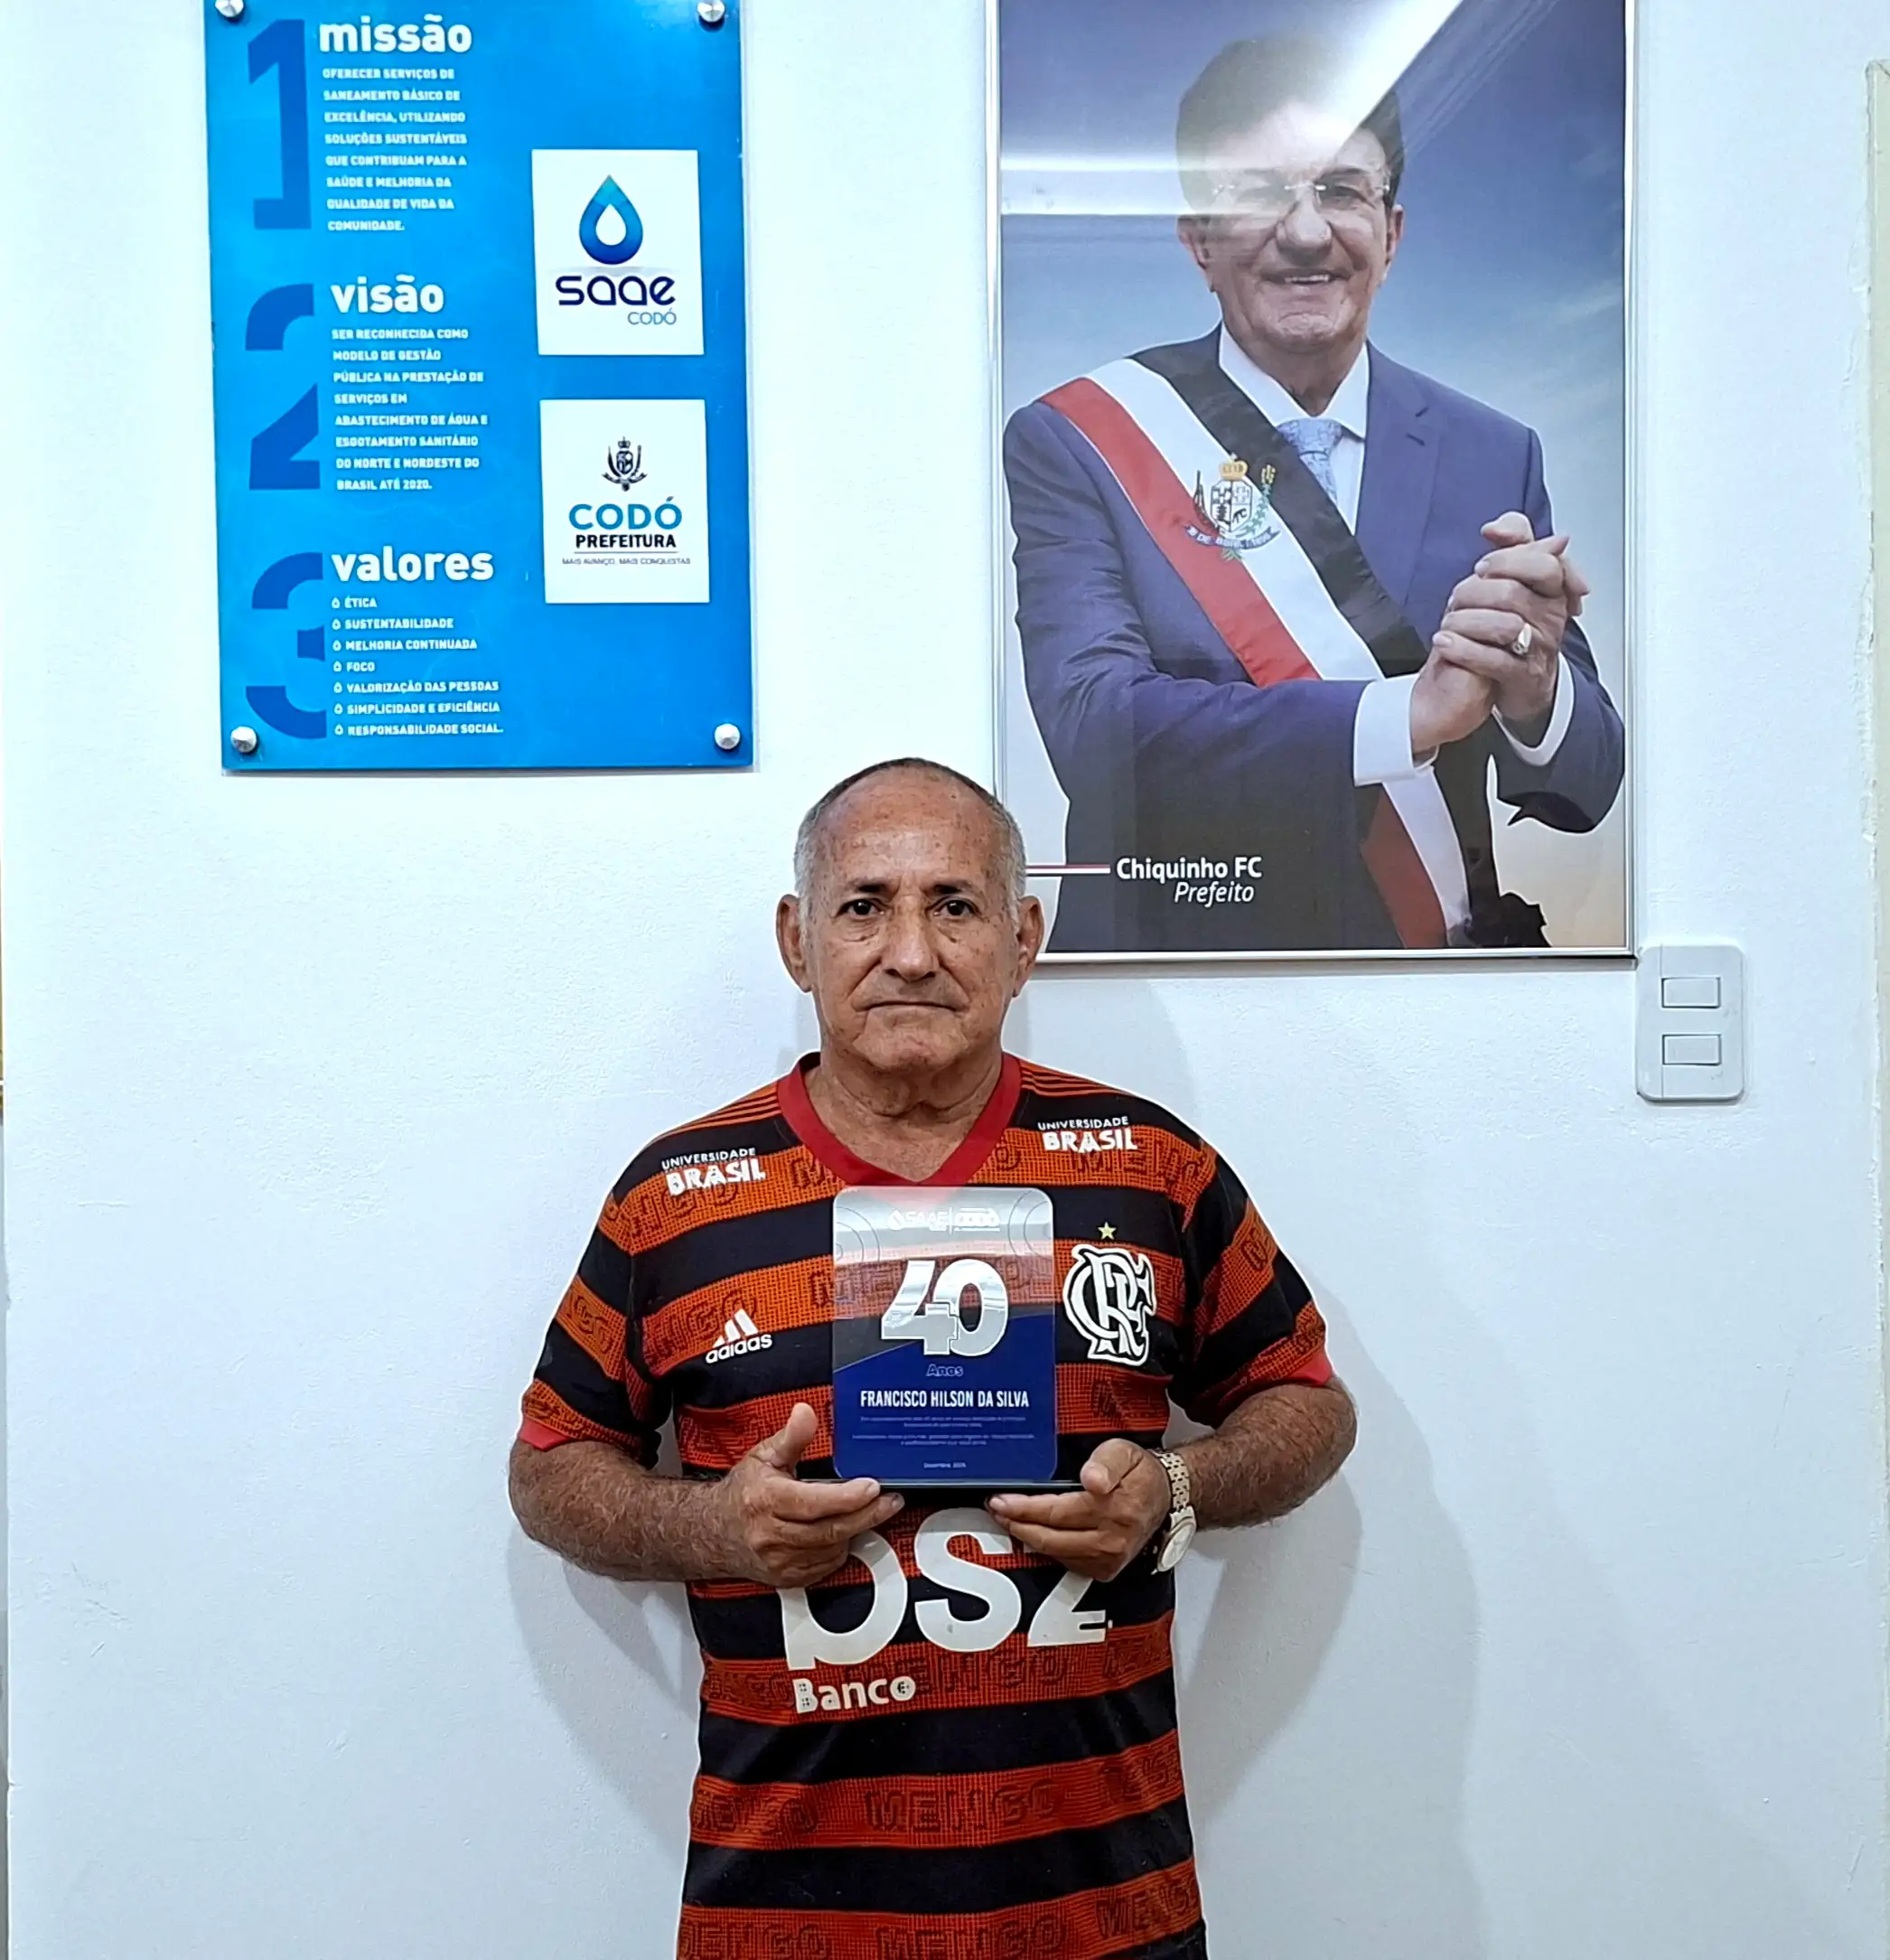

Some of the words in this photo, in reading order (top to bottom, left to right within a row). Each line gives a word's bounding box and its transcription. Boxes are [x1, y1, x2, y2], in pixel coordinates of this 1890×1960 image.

[319, 14, 472, 53] missão
[323, 68, 380, 80] OFERECER
[384, 68, 437, 80] SERVIÇOS
[440, 69, 454, 80] DE
[323, 90, 399, 101] SANEAMENTO
[403, 88, 443, 101] BÁSICO
[445, 90, 460, 101] DE
[324, 110, 398, 124] EXCELÊNCIA,
[399, 112, 465, 123] UTILIZANDO
[248, 19, 312, 230] 1
[325, 132, 382, 146] SOLUÇÕES
[385, 133, 467, 145] SUSTENTÁVEIS
[325, 156, 348, 165] QUE
[351, 156, 424, 165] CONTRIBUAM
[426, 156, 455, 165] PARA
[458, 156, 467, 165] A
[326, 175, 363, 188] SAÚDE
[366, 177, 373, 187] E
[376, 177, 434, 187] MELHORIA
[436, 177, 452, 187] DA
[327, 199, 389, 210] QUALIDADE
[393, 199, 407, 209] DE
[409, 199, 435, 209] VIDA
[438, 199, 454, 209] DA
[328, 220, 405, 230] COMUNIDADE.
[331, 275, 444, 313] visão
[556, 275, 676, 306] saae
[627, 308, 677, 325] CODÓ
[332, 330, 353, 340] SER
[356, 329, 435, 339] RECONHECIDA
[437, 329, 468, 339] COMO
[333, 351, 379, 361] MODELO
[381, 351, 396, 361] DE
[398, 348, 441, 360] GESTÃO
[333, 370, 381, 382] PÚBLICA
[384, 372, 399, 382] NA
[402, 370, 466, 384] PRESTAÇÃO
[469, 372, 483, 381] DE
[245, 283, 320, 490] 2
[334, 394, 388, 406] SERVIÇOS
[391, 394, 407, 404] EM
[335, 416, 427, 426] ABASTECIMENTO
[431, 415, 445, 425] DE
[448, 413, 478, 425] ÁGUA
[481, 415, 488, 425] E
[336, 437, 416, 447] ESGOTAMENTO
[419, 434, 478, 446] SANITÁRIO
[336, 459, 351, 468] DO
[354, 459, 390, 468] NORTE
[394, 459, 401, 468] E
[403, 458, 462, 468] NORDESTE
[464, 458, 479, 468] DO
[337, 480, 377, 490] BRASIL
[379, 478, 400, 490] ATÉ
[403, 480, 432, 490] 2020.
[569, 496, 682, 530] CODÓ
[575, 534, 677, 549] PREFEITURA
[331, 546, 494, 582] valores
[344, 596, 378, 608] ÉTICA
[344, 619, 454, 629] SUSTENTABILIDADE
[346, 641, 403, 651] MELHORIA
[406, 639, 477, 650] CONTINUADA
[347, 661, 375, 671] FOCO
[347, 680, 423, 695] VALORIZAÇÃO
[425, 682, 446, 692] DAS
[449, 681, 499, 691] PESSOAS
[347, 704, 426, 715] SIMPLICIDADE
[428, 704, 435, 713] E
[438, 701, 500, 713] EFICIÊNCIA
[348, 725, 458, 736] RESPONSABILIDADE
[461, 725, 503, 734] SOCIAL.
[1117, 857, 1228, 884] Chiquinho
[1235, 857, 1262, 877] FC
[1174, 881, 1254, 907] Prefeito
[1038, 1116, 1128, 1130] UNIVERSIDADE
[1043, 1129, 1137, 1153] BRASIL
[661, 1148, 755, 1169] UNIVERSIDADE
[665, 1158, 766, 1196] BRASIL
[882, 1259, 1008, 1356] 40
[705, 1334, 772, 1364] adidas
[926, 1364, 964, 1377] Anos
[860, 1391, 927, 1407] FRANCISCO
[931, 1391, 974, 1407] HILSON
[978, 1391, 994, 1407] DA
[996, 1391, 1029, 1407] SILVA
[792, 1675, 916, 1713] Banco
